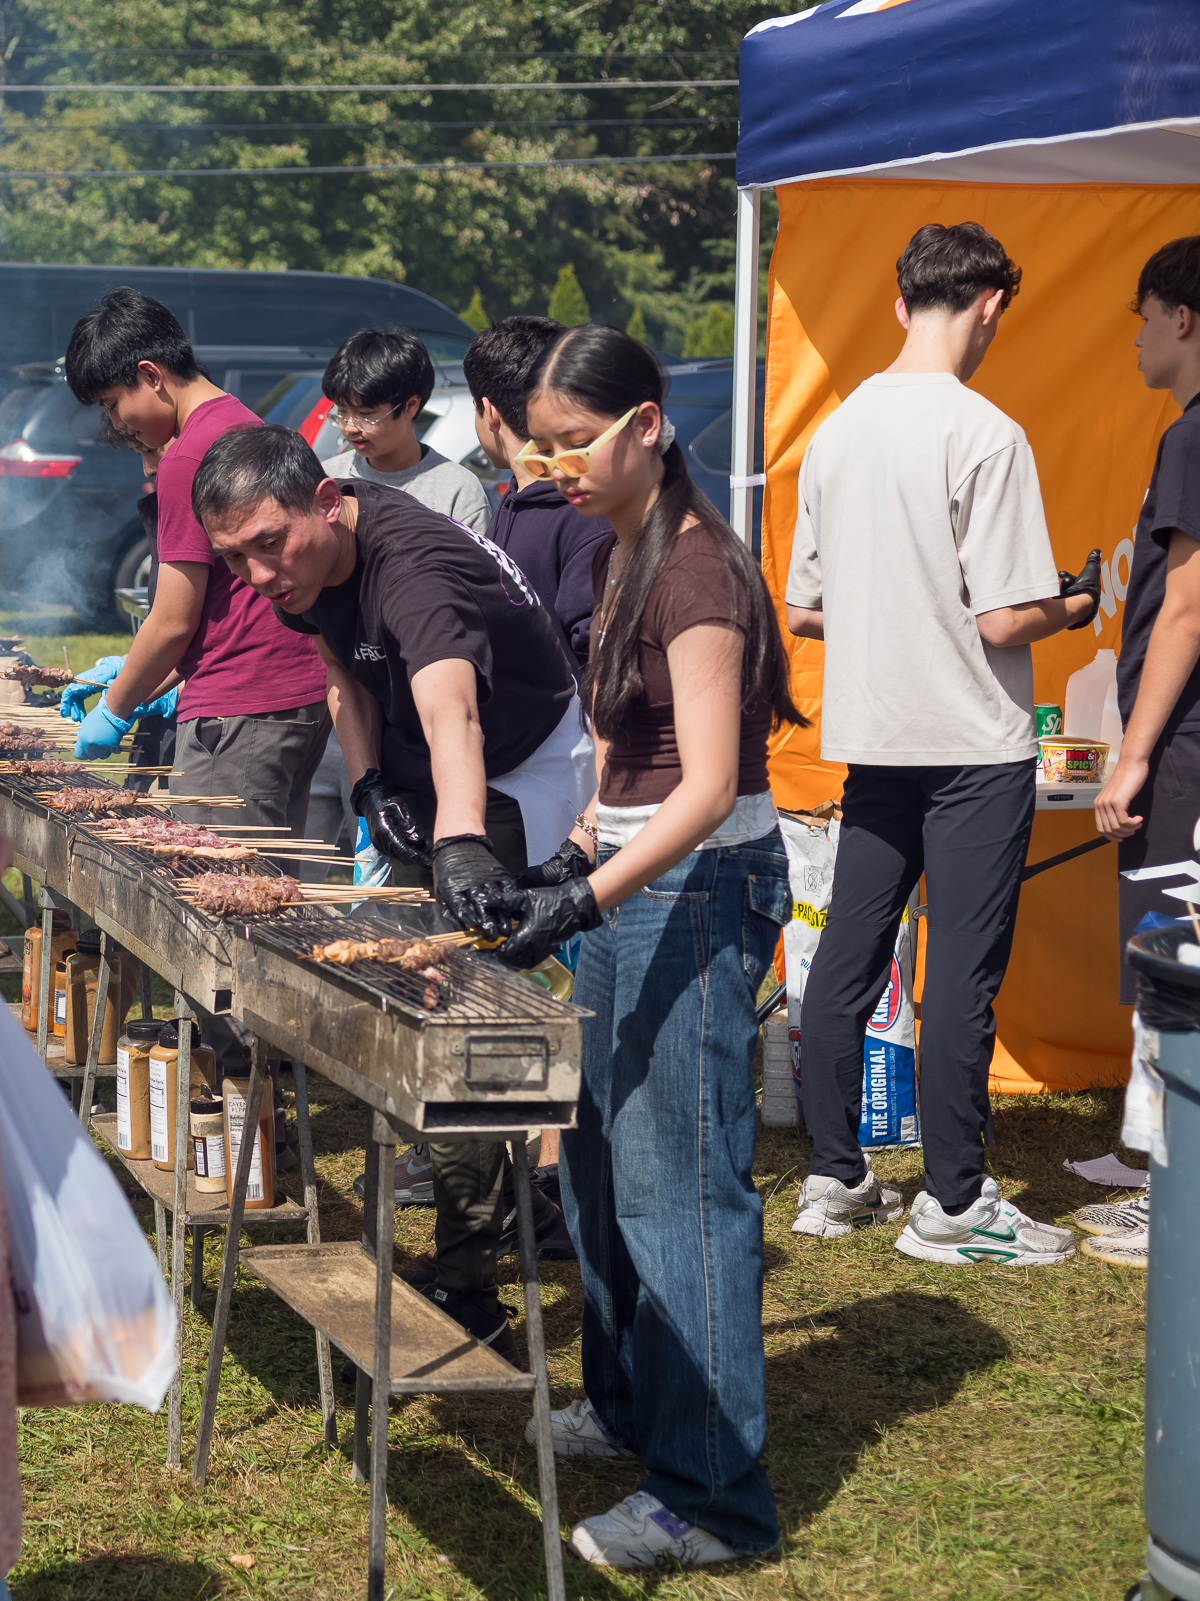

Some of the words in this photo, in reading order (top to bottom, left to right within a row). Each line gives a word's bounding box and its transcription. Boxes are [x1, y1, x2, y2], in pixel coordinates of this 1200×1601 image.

[1092, 523, 1138, 638] NO
[1066, 760, 1094, 770] SPICY
[869, 1046, 887, 1111] ORIGINAL
[872, 1112, 888, 1138] THE
